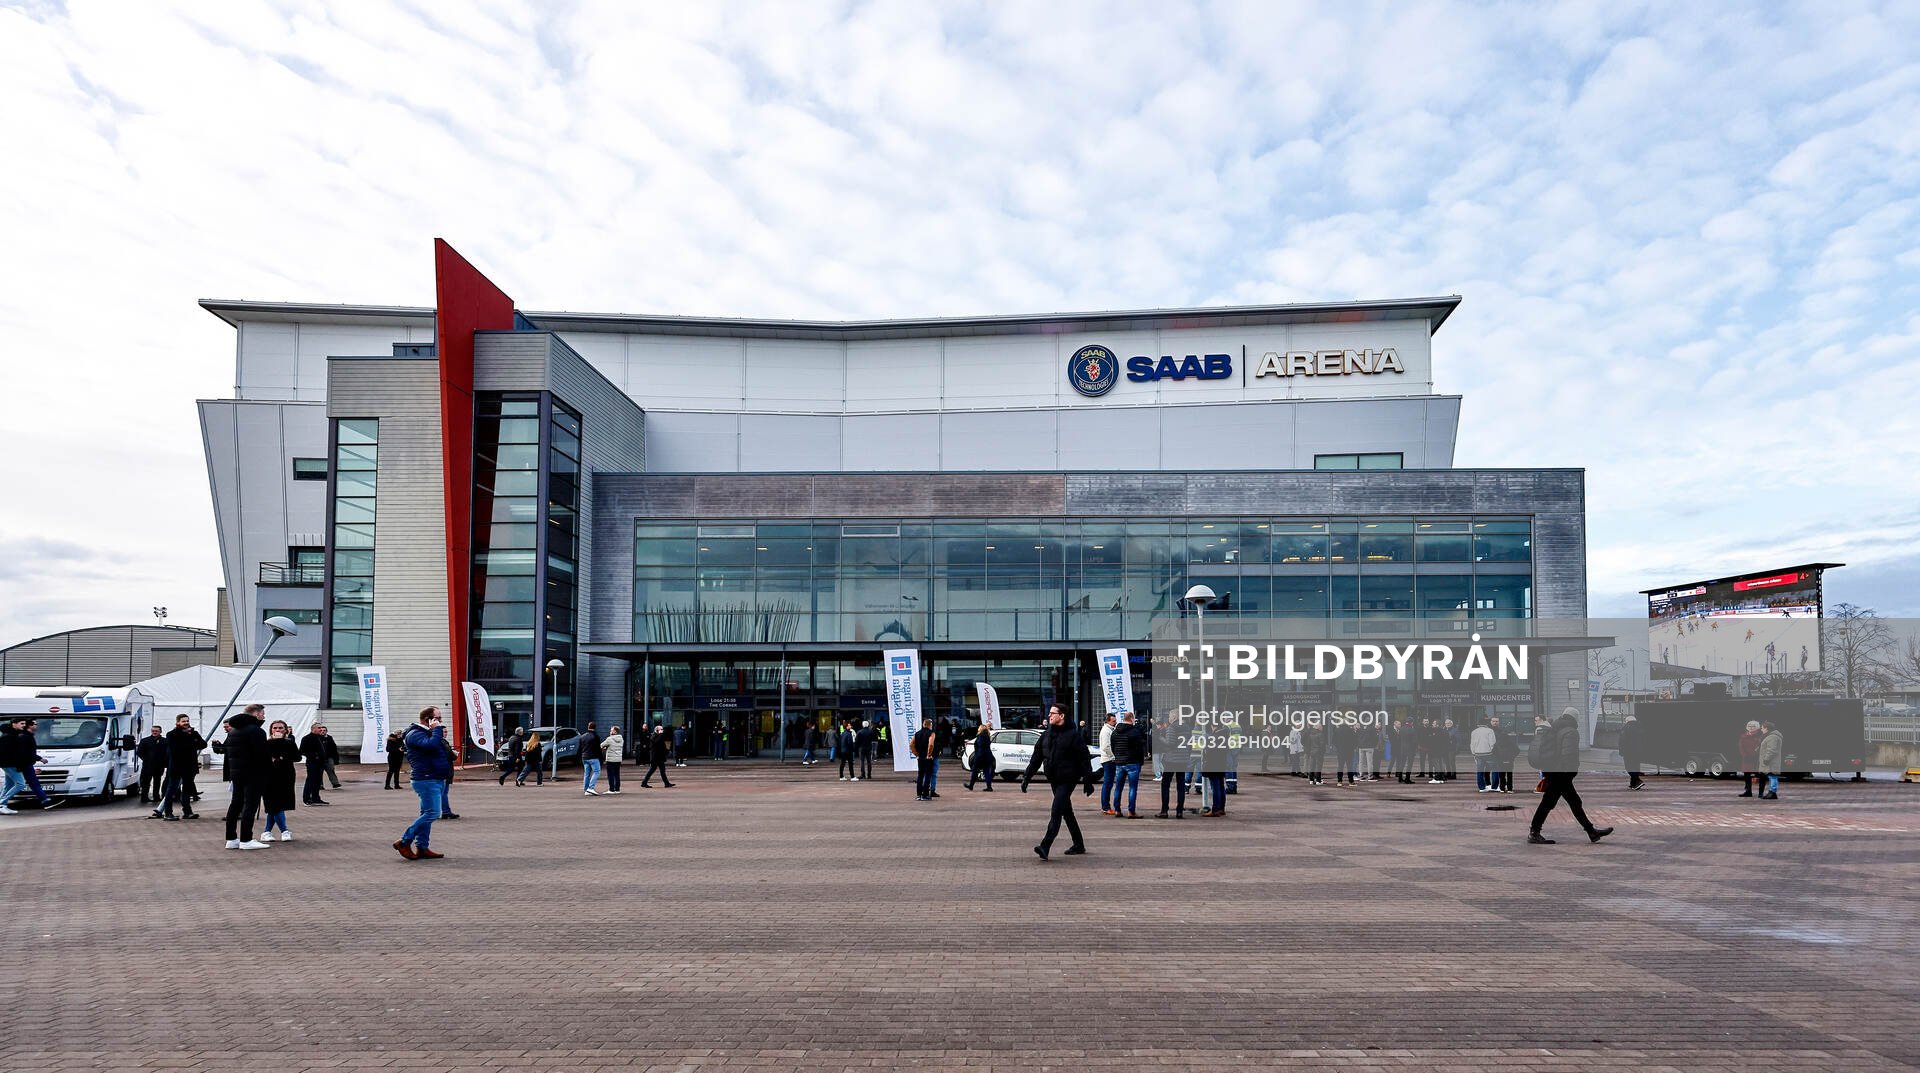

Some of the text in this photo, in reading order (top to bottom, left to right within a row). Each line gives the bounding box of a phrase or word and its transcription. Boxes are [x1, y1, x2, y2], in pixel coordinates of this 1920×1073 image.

[1081, 349, 1106, 359] SAAB
[1126, 348, 1404, 382] SAAB ARENA
[1151, 655, 1189, 663] ARENA
